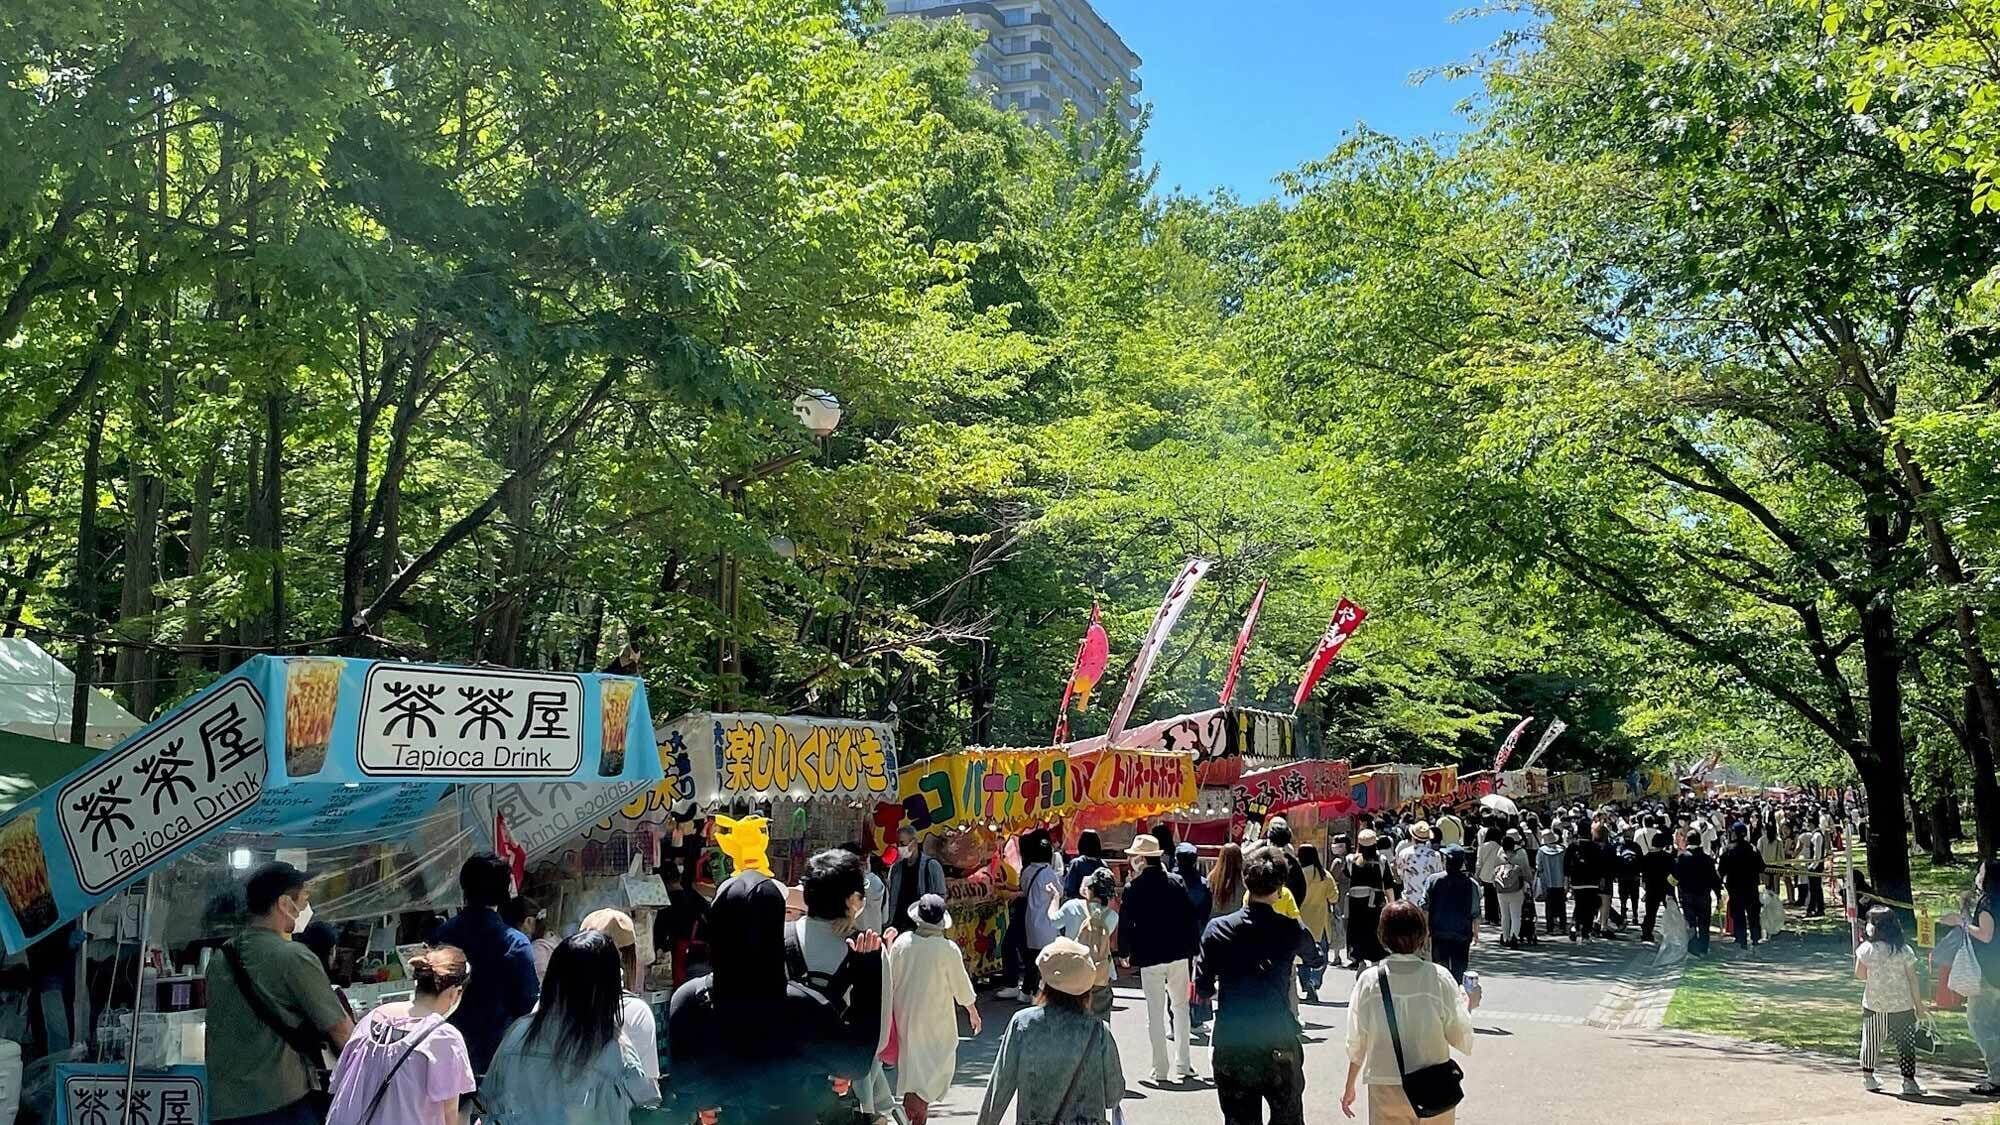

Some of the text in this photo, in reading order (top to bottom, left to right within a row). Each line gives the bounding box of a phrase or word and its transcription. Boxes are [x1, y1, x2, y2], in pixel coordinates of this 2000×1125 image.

[380, 681, 570, 740] 茶茶屋
[73, 702, 263, 852] 茶茶屋
[392, 744, 551, 771] Tapioca Drink
[725, 720, 888, 794] 楽しいくじびき
[963, 757, 1066, 818] バナナチョコ
[1109, 753, 1184, 799] トルネードポテト
[104, 812, 192, 873] Tapioca
[193, 770, 260, 821] Drink
